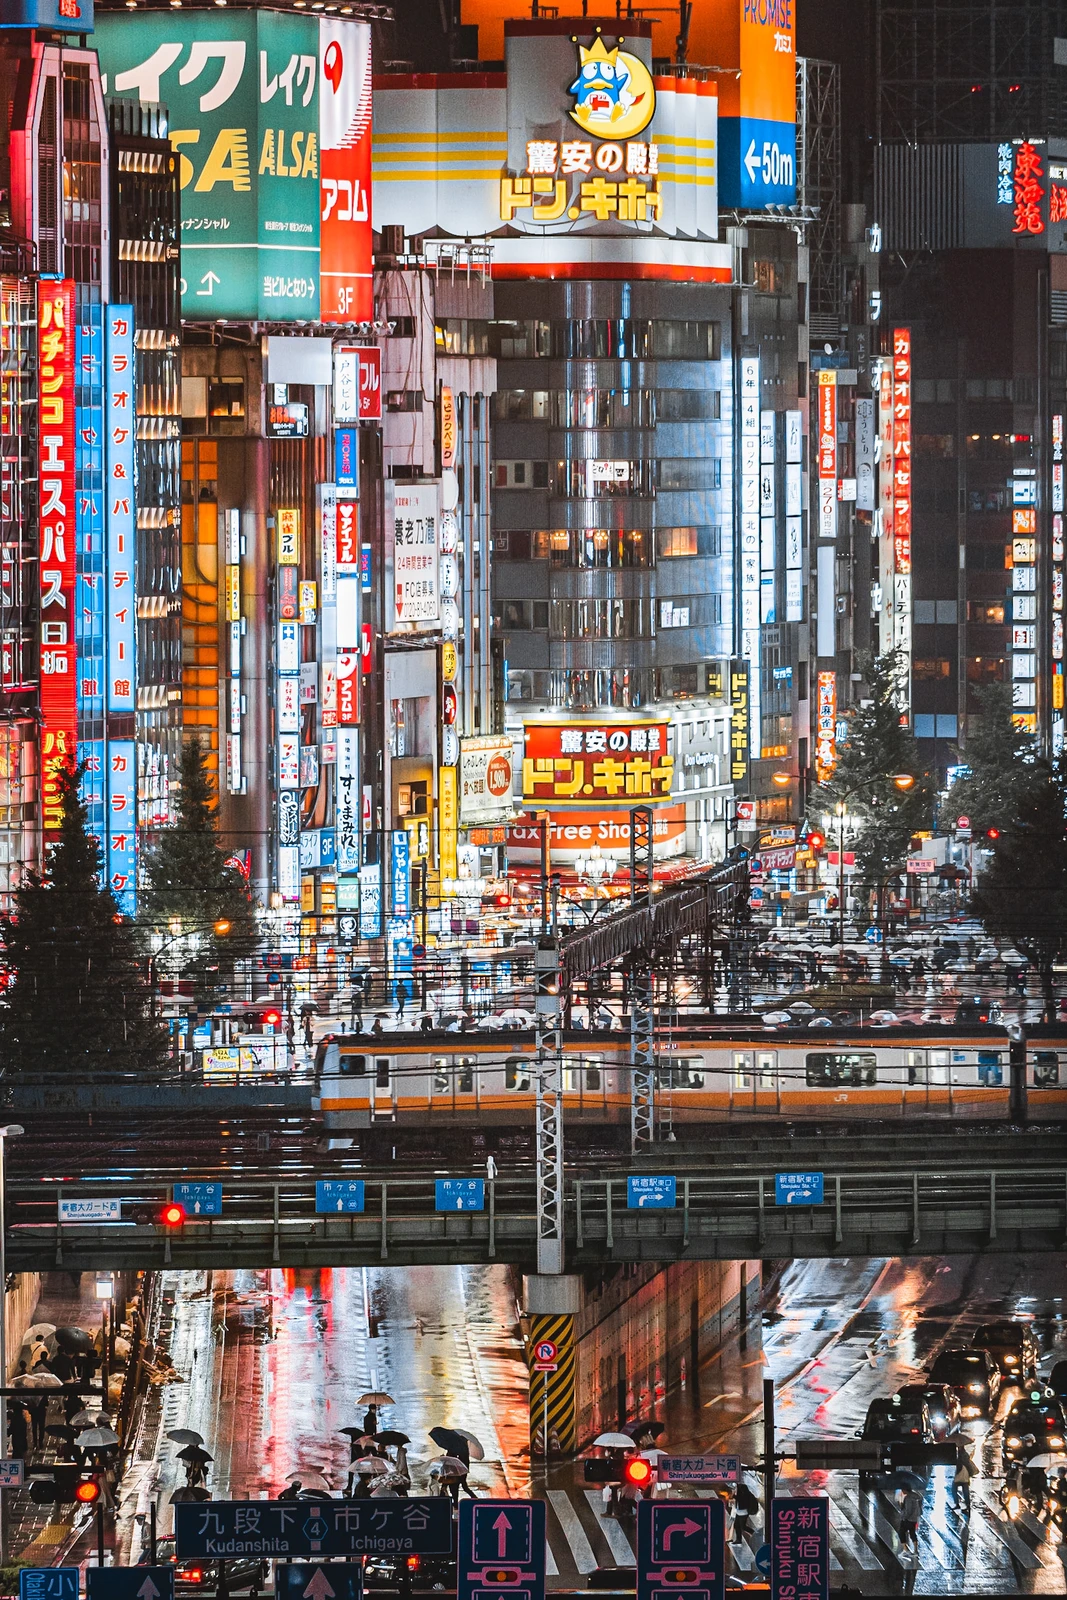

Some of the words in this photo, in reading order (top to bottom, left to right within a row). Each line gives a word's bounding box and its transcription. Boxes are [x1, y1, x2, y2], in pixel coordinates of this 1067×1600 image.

[260, 51, 317, 108] レイク
[259, 128, 318, 179] ALSA
[526, 140, 658, 174] 驚安の殿堂
[762, 142, 794, 187] 50m
[322, 179, 368, 222] アコム
[263, 276, 307, 297] 当ビルとなり
[338, 287, 354, 314] 3F
[340, 360, 353, 412] 戸谷ビル
[821, 374, 833, 383] 8F
[342, 434, 350, 474] PROMISE
[112, 319, 130, 697] カラオケ&パーティー館
[341, 517, 353, 562] アイフル
[341, 680, 352, 712] アコム
[820, 704, 833, 729] 麻雀
[560, 729, 661, 753] 驚安の殿堂
[685, 753, 695, 766] Don
[111, 755, 128, 891] カラオケ
[339, 773, 356, 849] すしまみれ
[549, 822, 592, 839] Free
[322, 838, 333, 856] 3F
[395, 847, 407, 902] じゃんぱら
[834, 1094, 848, 1102] JR
[631, 1178, 672, 1187] 新宿駅東口
[779, 1175, 819, 1184] 新宿駅東口
[62, 1201, 117, 1211] 新宿大ガード西
[662, 1458, 736, 1470] 新宿大ガード西
[198, 1508, 297, 1535] 九段下
[311, 1521, 321, 1536] 4
[205, 1538, 290, 1553] Kudanshita
[351, 1536, 413, 1551] Ichigaya
[778, 1510, 796, 1578] Shinjuku
